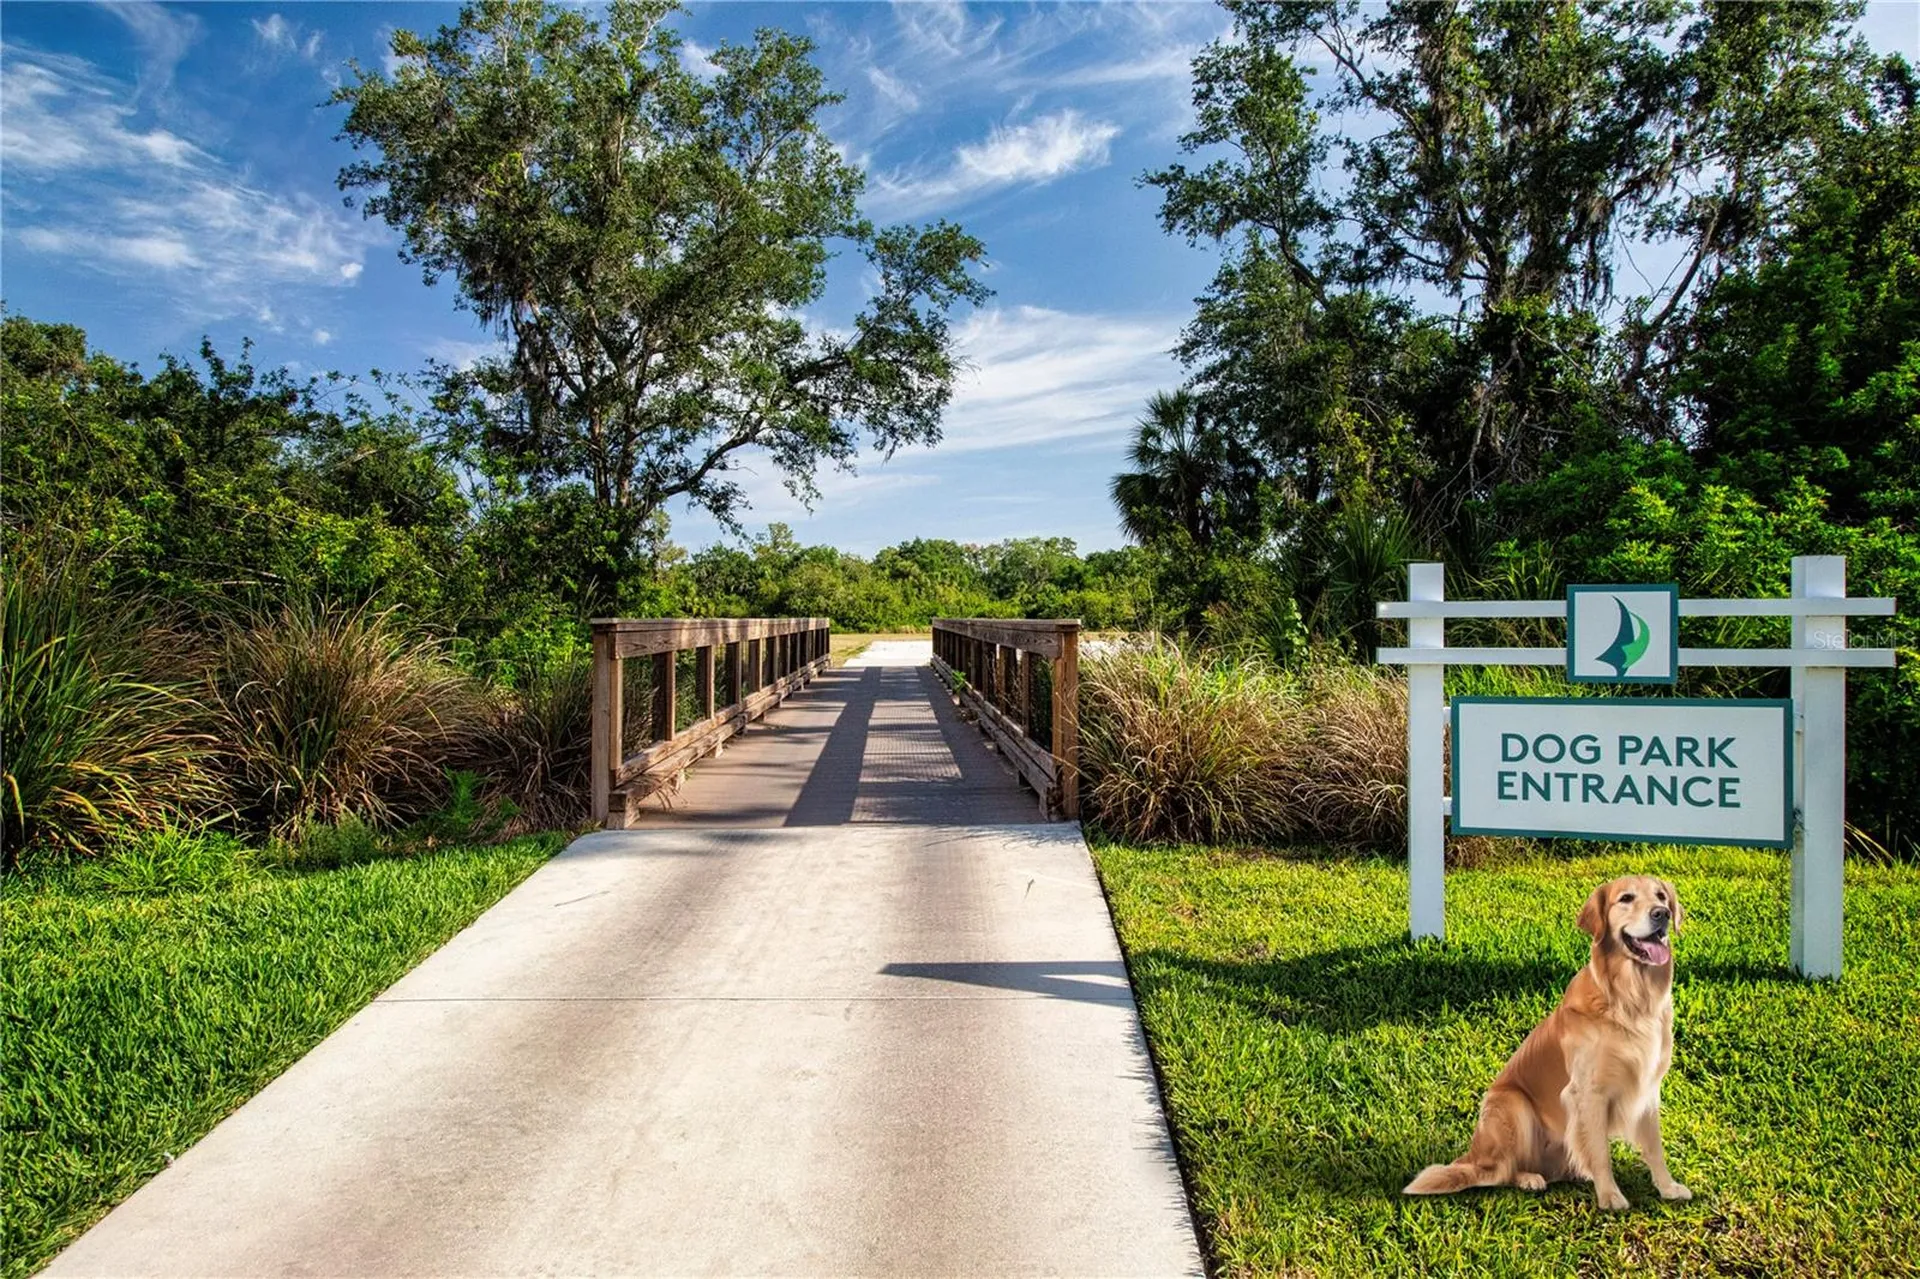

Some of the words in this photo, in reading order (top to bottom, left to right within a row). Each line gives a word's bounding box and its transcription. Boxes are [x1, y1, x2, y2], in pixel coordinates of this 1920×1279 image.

[1501, 732, 1601, 764] DOG
[1618, 735, 1738, 768] PARK
[1497, 771, 1741, 808] ENTRANCE
